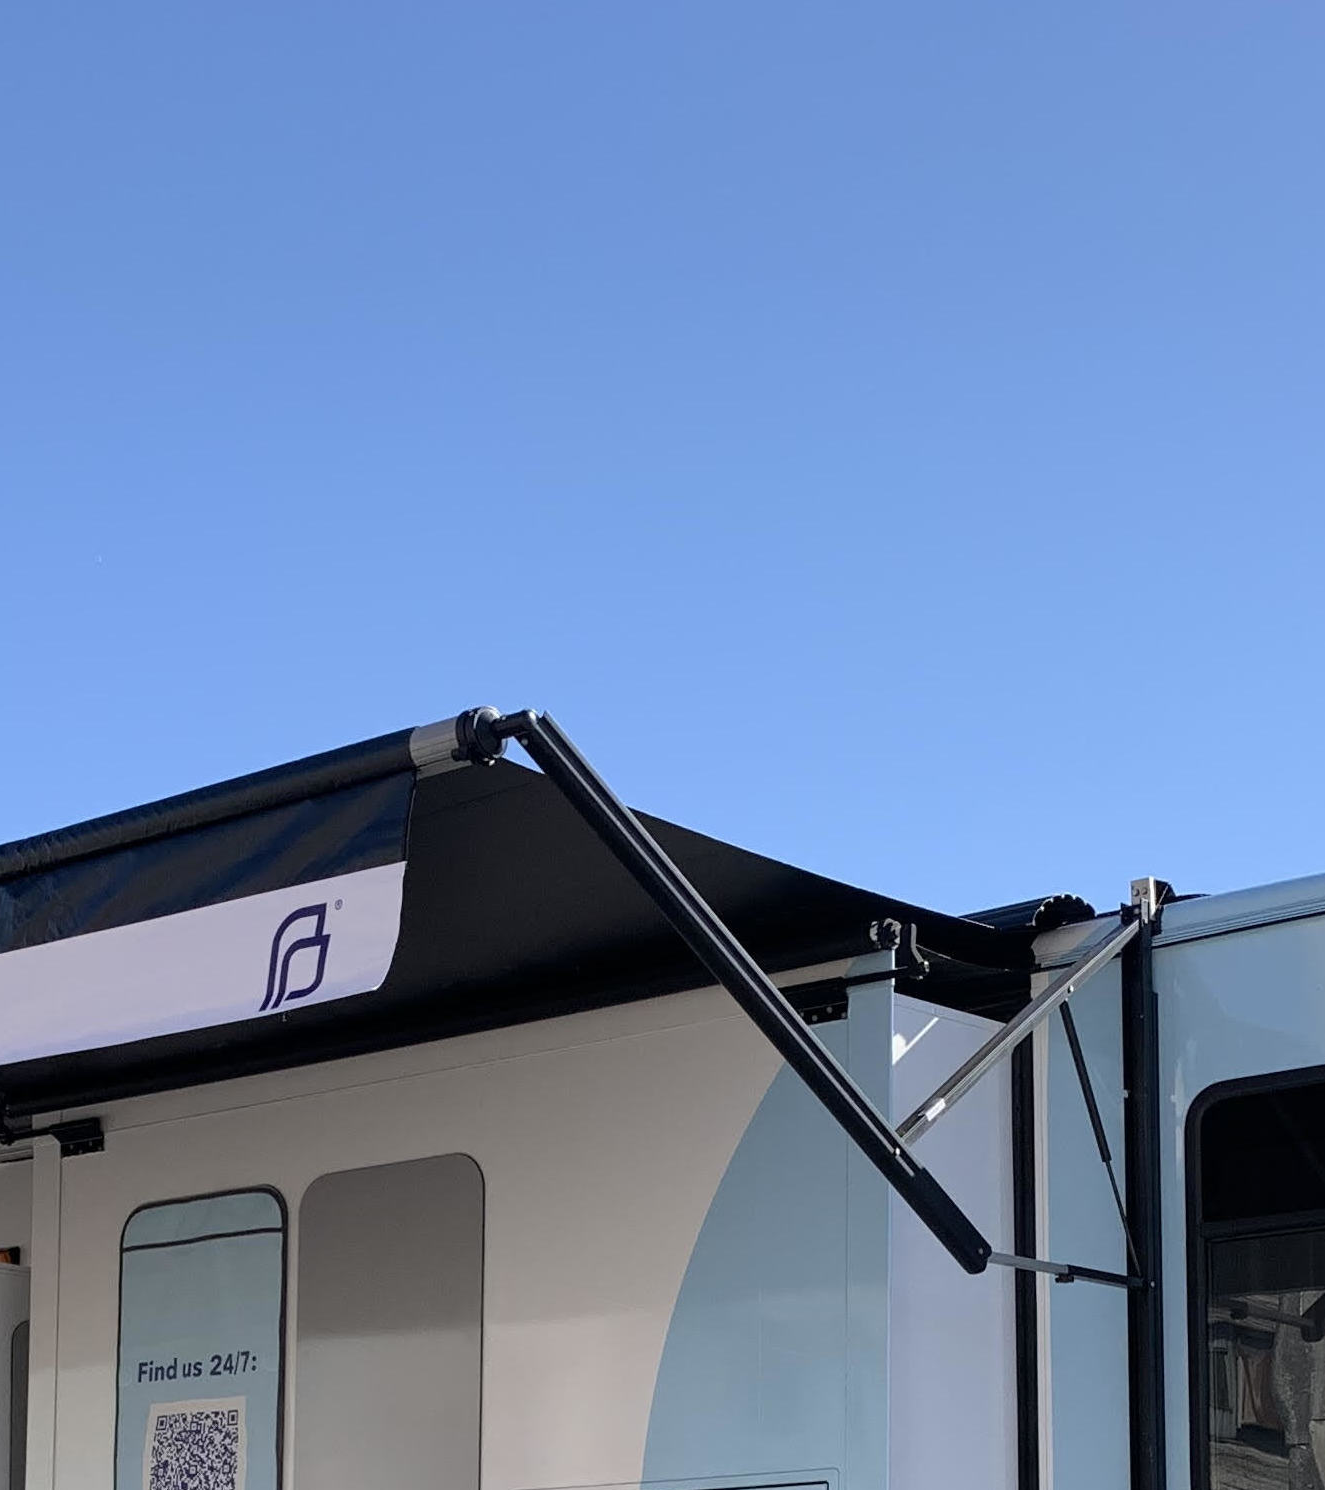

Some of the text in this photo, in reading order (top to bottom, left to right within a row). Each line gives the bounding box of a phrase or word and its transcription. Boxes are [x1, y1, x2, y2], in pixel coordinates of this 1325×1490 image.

[137, 1350, 257, 1383] Find us 24/7:
